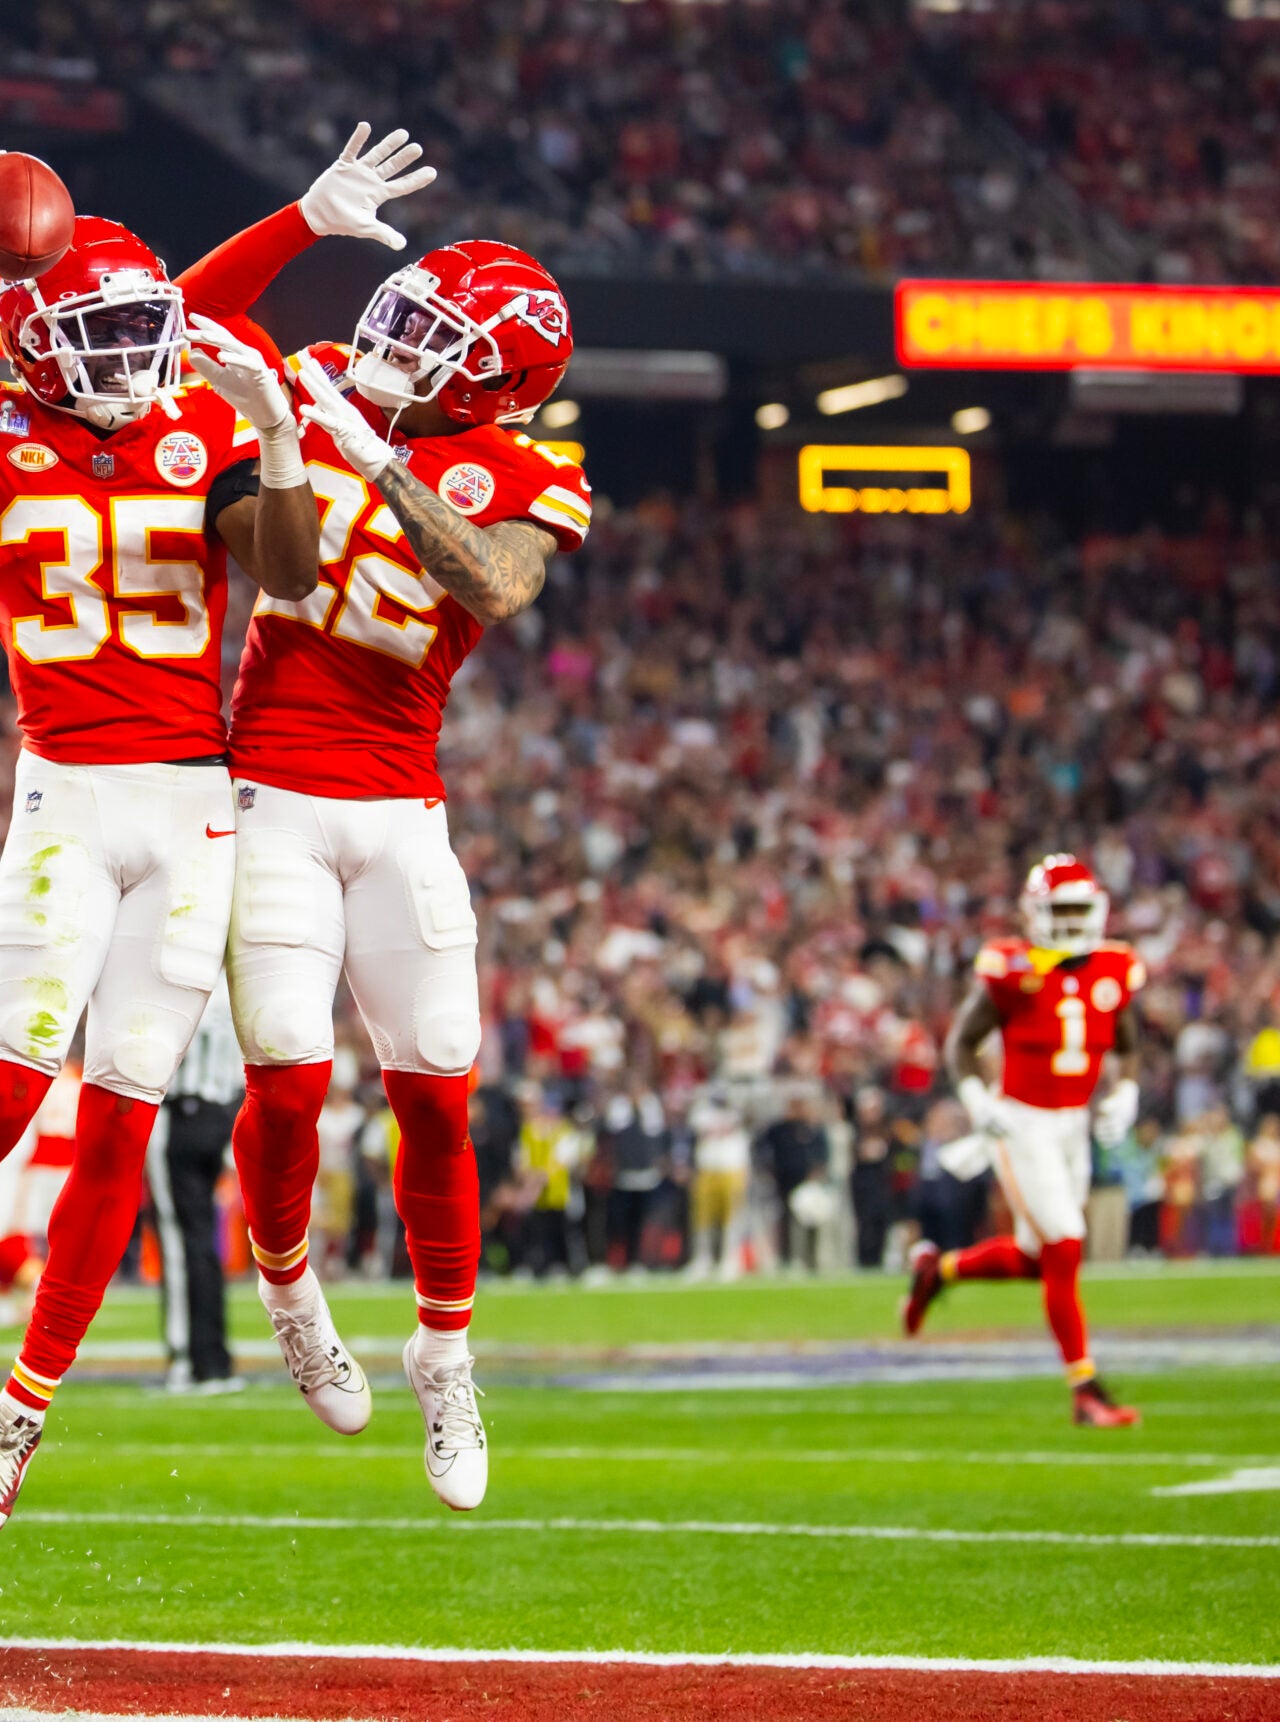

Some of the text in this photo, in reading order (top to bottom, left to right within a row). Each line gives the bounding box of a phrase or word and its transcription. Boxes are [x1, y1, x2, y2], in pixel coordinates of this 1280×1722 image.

[20, 450, 45, 465] NKH
[254, 459, 448, 669] 22
[1051, 996, 1090, 1076] 1
